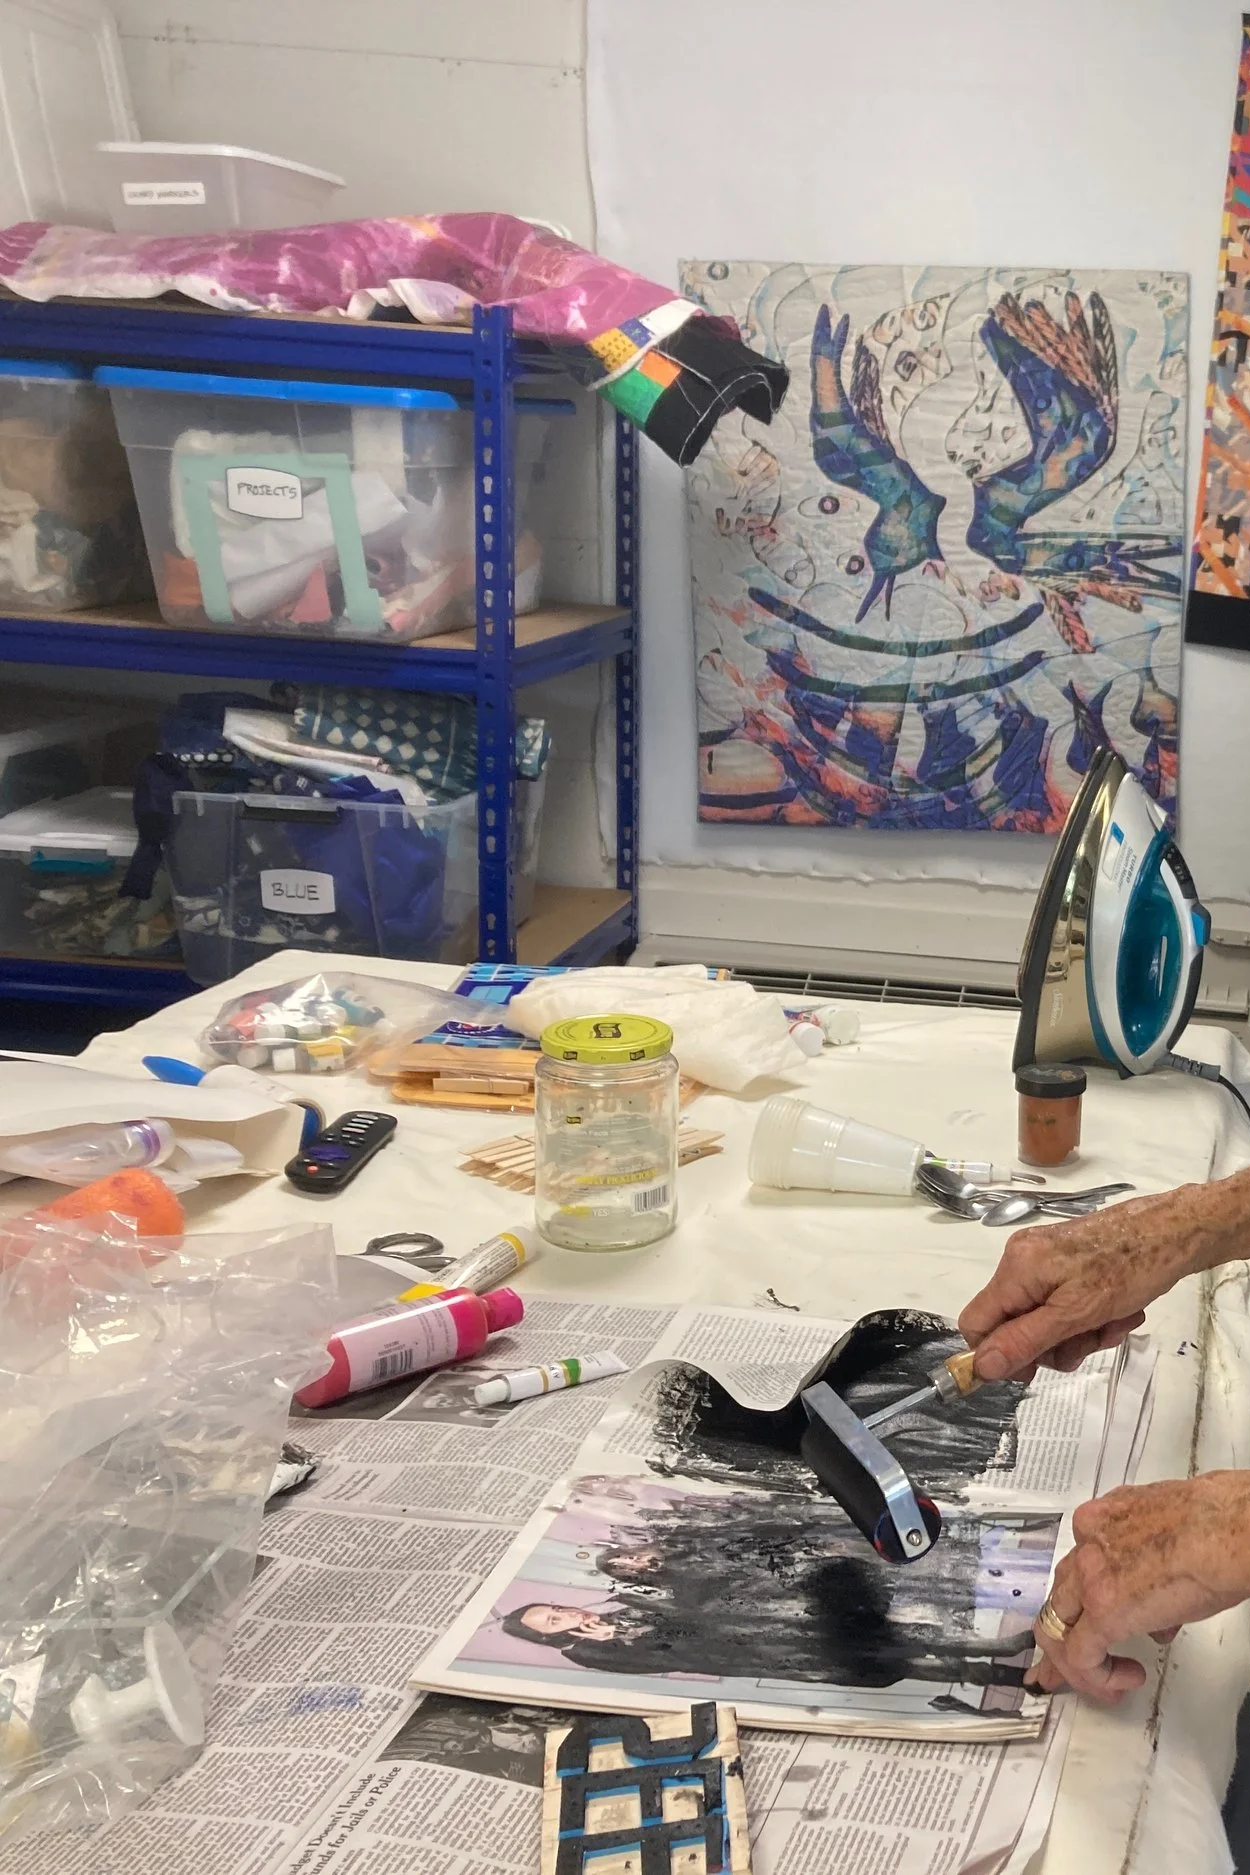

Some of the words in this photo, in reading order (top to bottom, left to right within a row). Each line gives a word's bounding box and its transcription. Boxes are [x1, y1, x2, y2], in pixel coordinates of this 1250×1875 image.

[237, 482, 298, 499] PROJECTS
[271, 882, 320, 900] BLUE
[369, 1765, 402, 1795] Police
[307, 1810, 347, 1847] Doesn't
[338, 1772, 376, 1808] Include
[364, 1796, 378, 1807] or
[341, 1807, 369, 1833] Jails
[328, 1832, 348, 1848] for
[303, 1849, 336, 1875] unds
